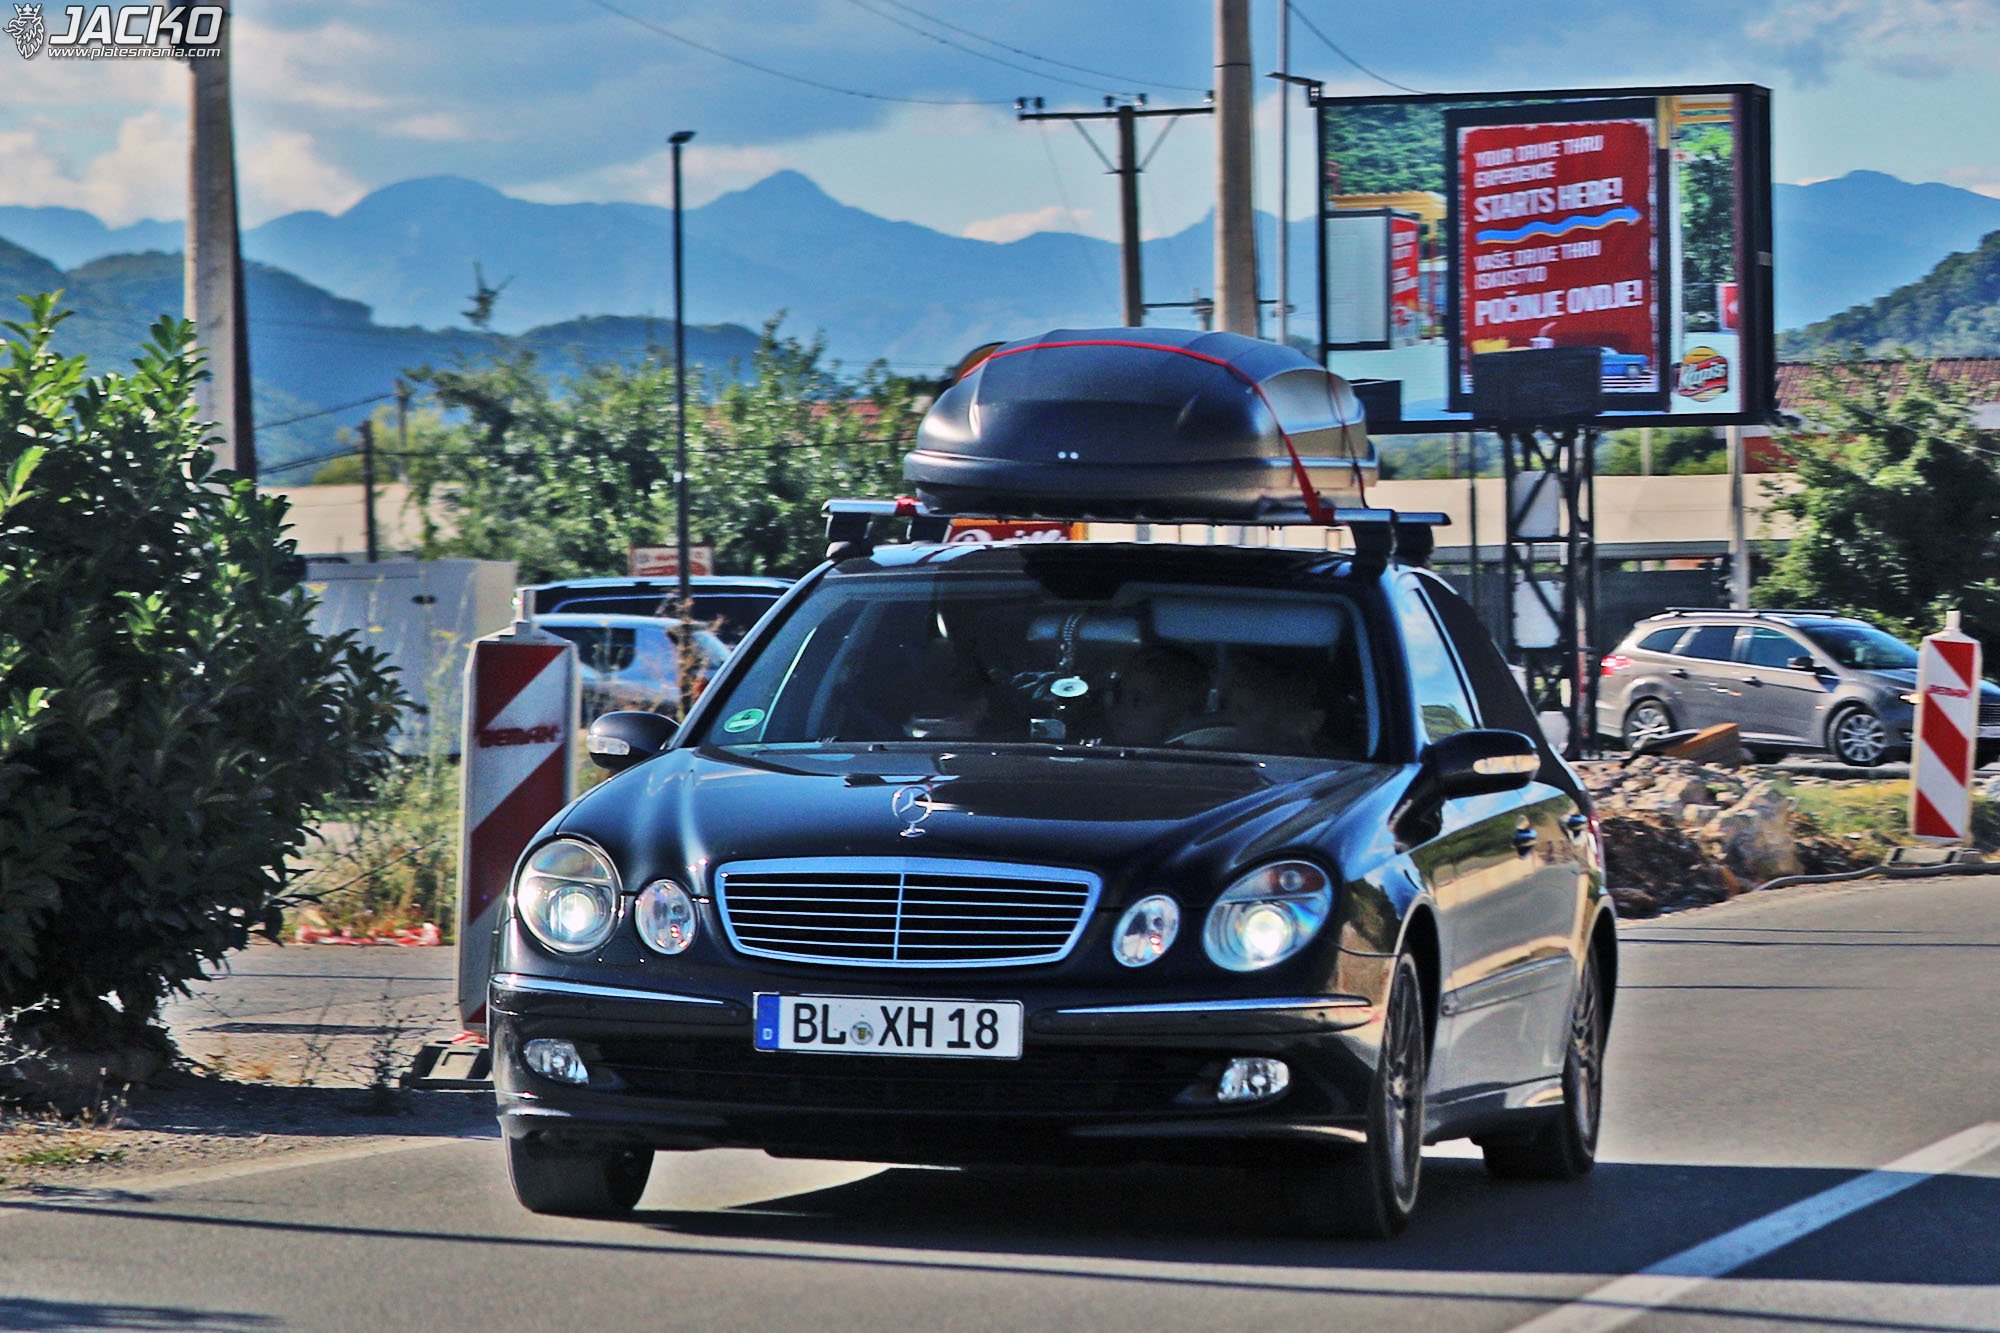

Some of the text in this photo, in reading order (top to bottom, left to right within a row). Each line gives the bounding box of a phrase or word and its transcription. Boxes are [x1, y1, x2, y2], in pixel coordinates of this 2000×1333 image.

[1474, 177, 1623, 222] STARTS HERE!
[1474, 279, 1643, 326] POČINJE OVDJE!
[793, 1003, 846, 1044] BL
[878, 1006, 934, 1048] XH
[947, 1008, 998, 1049] 18
